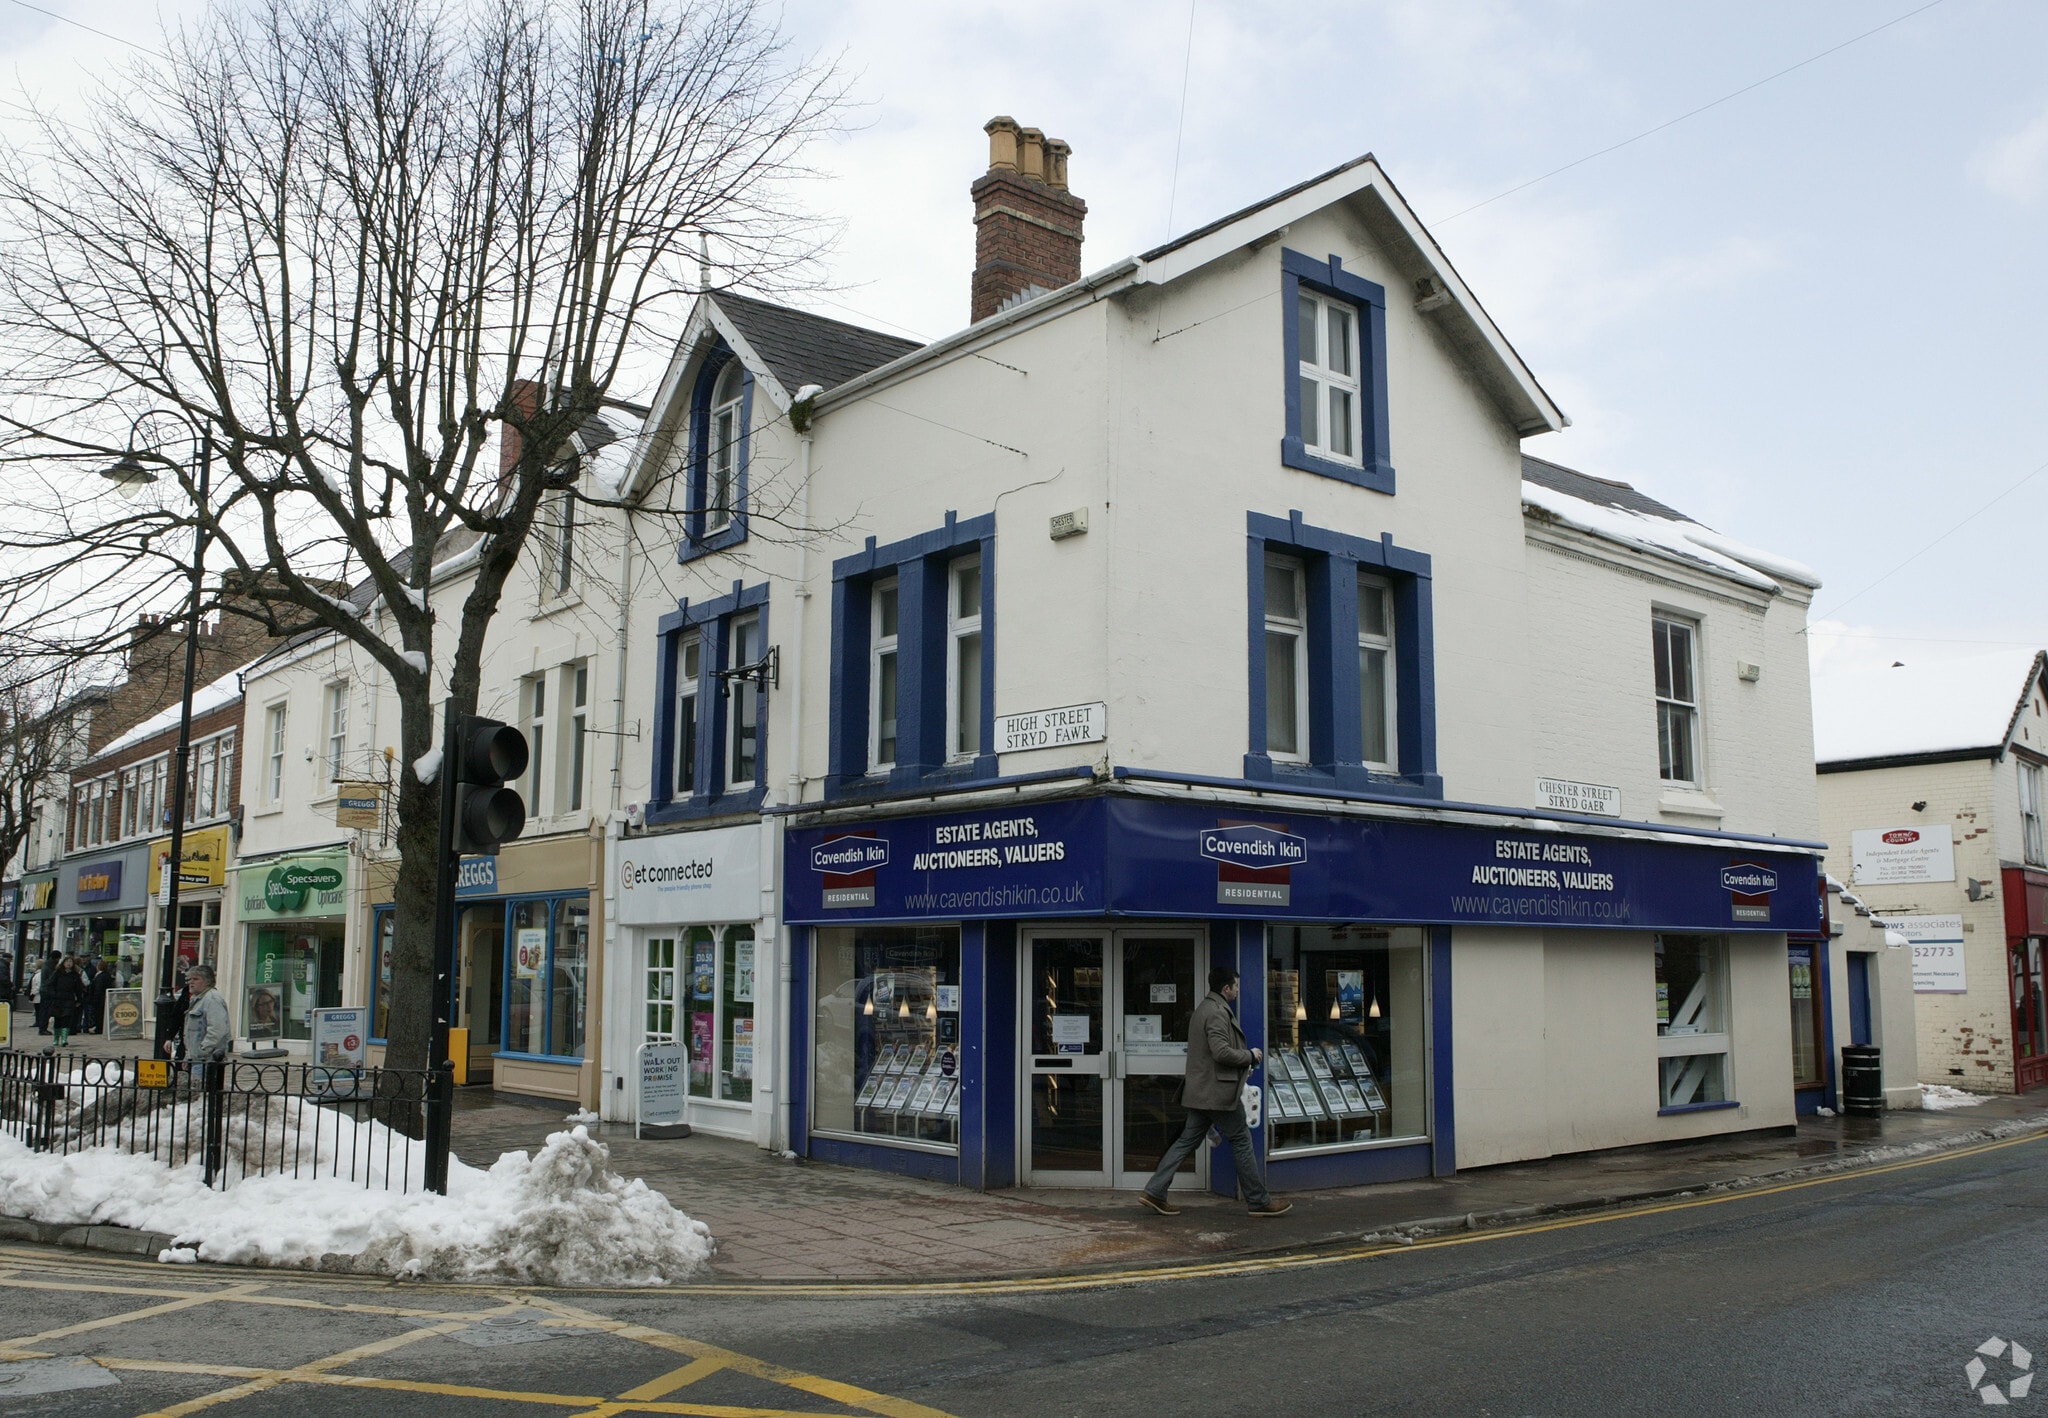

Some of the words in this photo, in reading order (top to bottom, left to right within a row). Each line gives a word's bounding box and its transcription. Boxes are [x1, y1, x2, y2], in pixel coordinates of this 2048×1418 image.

[1007, 716, 1038, 733] HIGH
[1045, 708, 1092, 728] STREET
[1007, 730, 1047, 749] STRYD
[1055, 725, 1090, 742] FAWR
[1540, 782, 1579, 796] CHESTER
[1582, 786, 1613, 801] STREET
[348, 800, 375, 808] GREGGS
[1549, 795, 1578, 809] STRYD
[1581, 800, 1605, 812] GAER
[936, 824, 981, 844] ESTATE
[982, 817, 1039, 840] AGENTS,
[815, 847, 864, 866] Cavendish
[866, 846, 885, 861] Ikin
[913, 848, 1002, 871] AUCTIONEERS,
[1005, 841, 1065, 864] VALUERS
[1206, 836, 1275, 856] Cavendish
[1280, 841, 1301, 857] Ikin
[1496, 840, 1540, 861] ESTATE
[1542, 844, 1592, 867] AGENTS,
[649, 857, 713, 882] connected
[1472, 865, 1561, 891] AUCTIONEERS,
[1562, 871, 1614, 891] VALUERS
[287, 874, 337, 885] Specsavers
[1723, 873, 1761, 886] Cavendish
[1762, 875, 1775, 887] Ikin
[20, 879, 54, 911] SUBWAY
[318, 888, 343, 908] Opticians
[827, 893, 870, 902] RESIDENTIAL
[905, 880, 1085, 910] www.cavendishikin.co.uk
[1225, 888, 1282, 899] RESIDENTIAL
[244, 895, 266, 913] Opticians
[1451, 894, 1631, 919] www.cavendishikin.co.uk
[1736, 909, 1767, 917] RESIDENTIAL
[1907, 919, 1961, 929] associates
[1914, 947, 1954, 957] 52773
[264, 952, 275, 984] Contac
[1151, 985, 1175, 994] OPEN
[644, 1058, 665, 1066] WALK
[644, 1065, 678, 1074] WORKING
[644, 1074, 673, 1082] PROMISE
